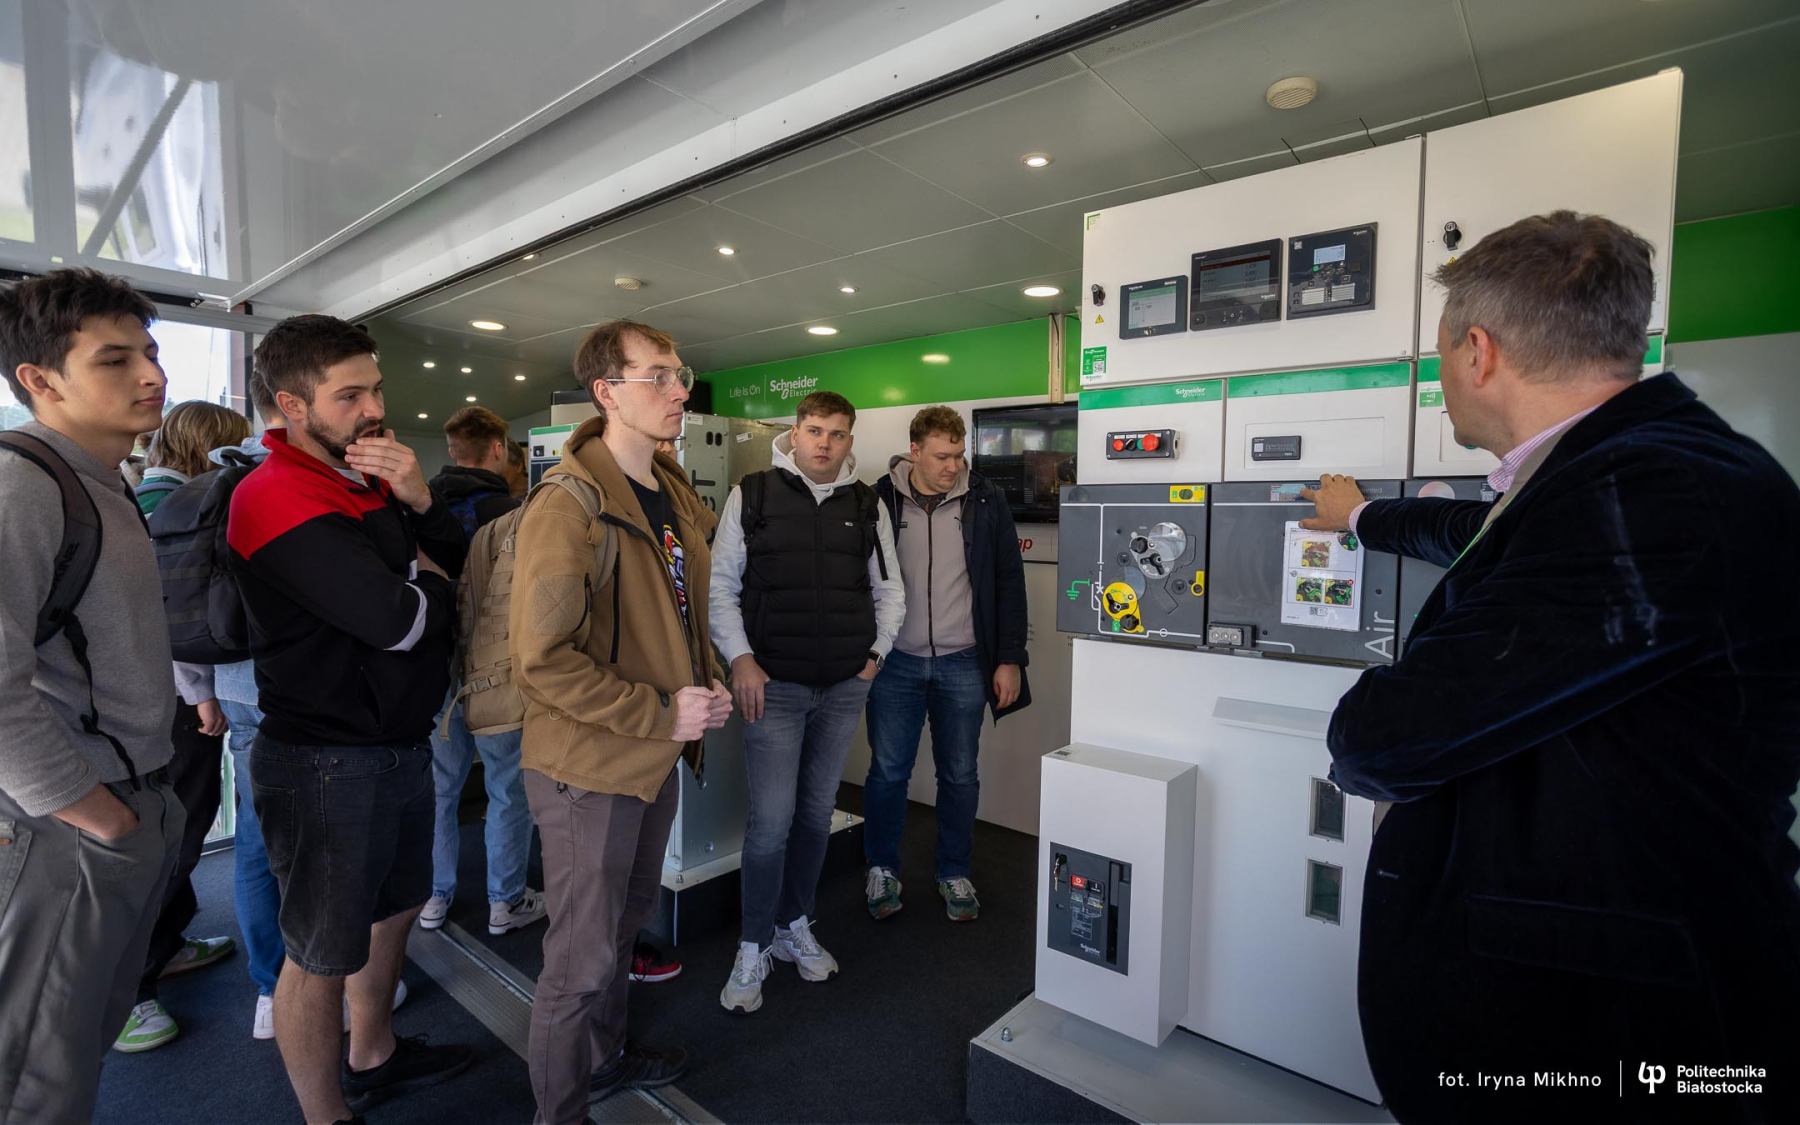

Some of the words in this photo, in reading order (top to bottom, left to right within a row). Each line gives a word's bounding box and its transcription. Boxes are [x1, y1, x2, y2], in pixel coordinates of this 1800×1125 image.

[729, 388, 741, 398] Life
[749, 384, 760, 395] On
[769, 376, 818, 393] Schneider
[1175, 387, 1206, 396] Schneider
[1364, 610, 1395, 660] Air
